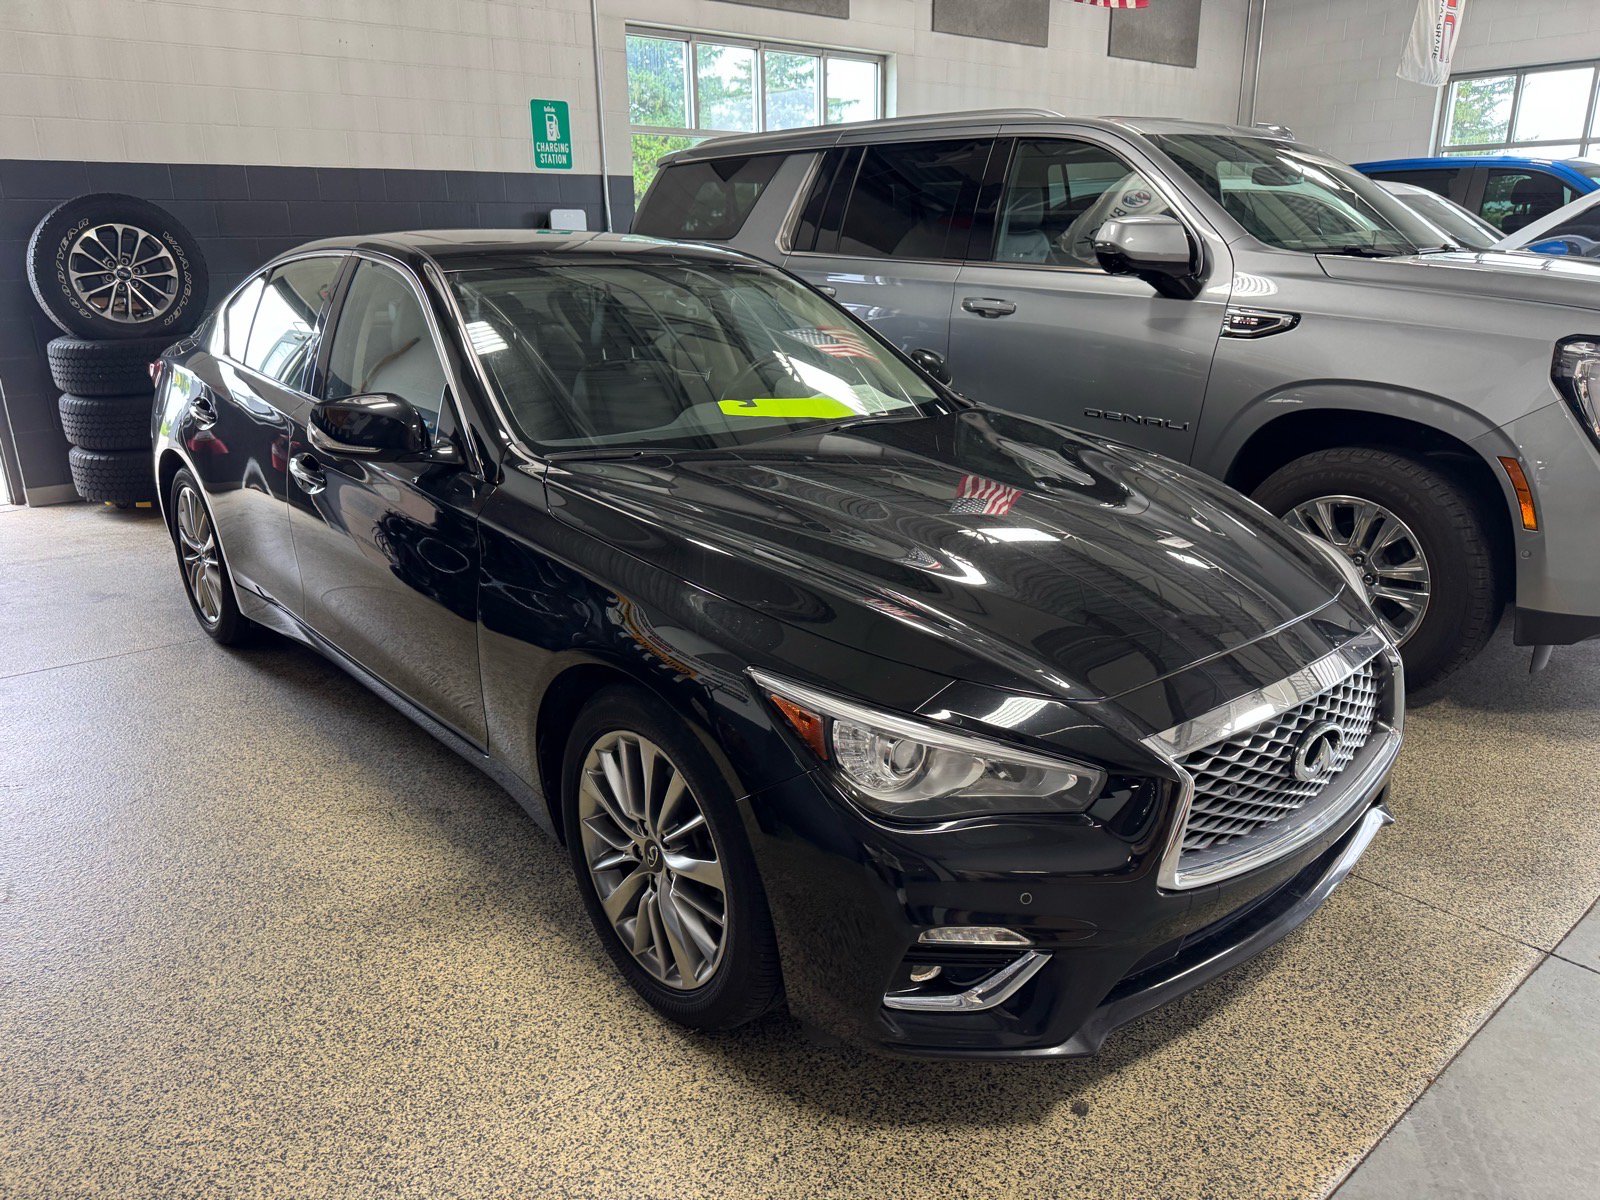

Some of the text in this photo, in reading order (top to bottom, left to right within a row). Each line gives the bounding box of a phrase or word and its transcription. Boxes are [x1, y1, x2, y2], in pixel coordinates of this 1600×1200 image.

[1431, 23, 1442, 59] GRADE
[536, 142, 569, 153] CHARGING
[540, 153, 567, 164] STATION
[55, 217, 92, 319] GOODYEAR
[162, 231, 193, 326] WRANGLER
[1083, 407, 1190, 431] DENALI
